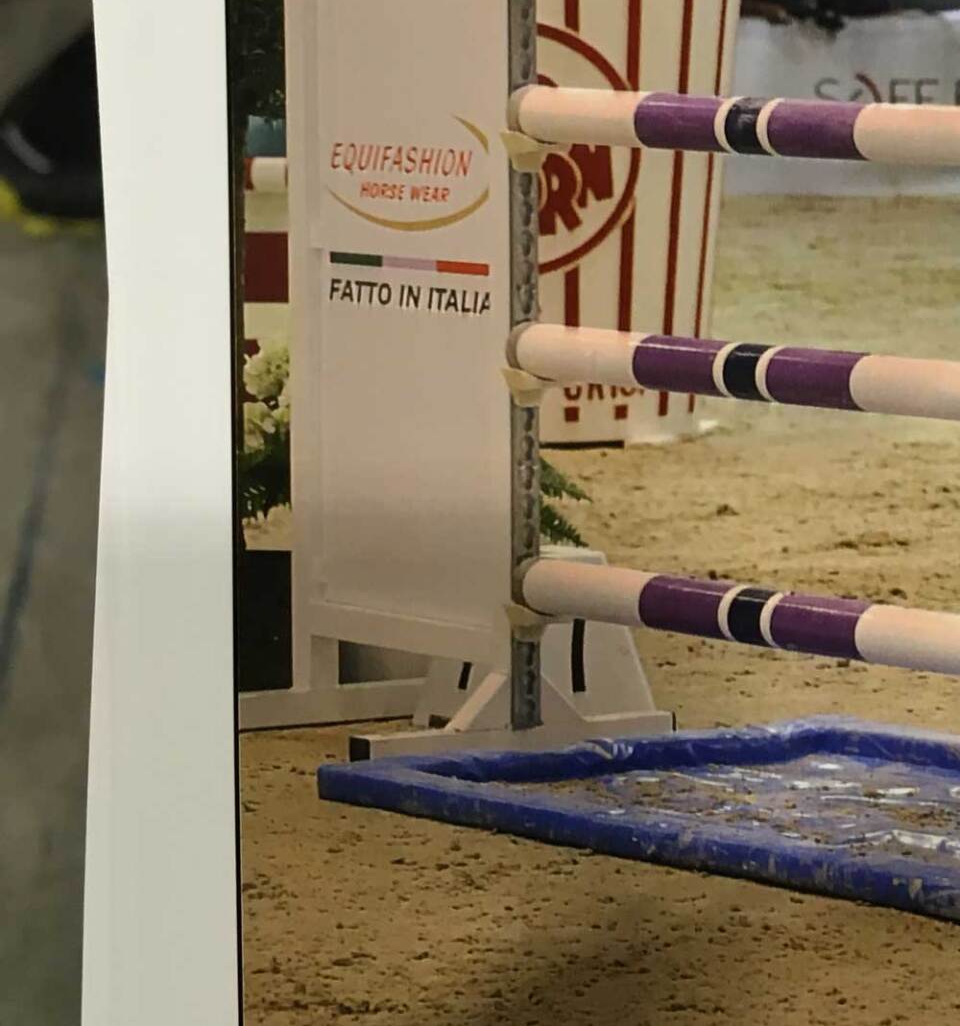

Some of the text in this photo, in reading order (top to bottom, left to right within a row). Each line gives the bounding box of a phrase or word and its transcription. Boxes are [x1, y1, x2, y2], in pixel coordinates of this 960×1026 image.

[330, 142, 472, 177] EQUIFASHION
[360, 181, 450, 203] HORSE WEAR
[329, 278, 491, 315] FATTO IN ITALIA
